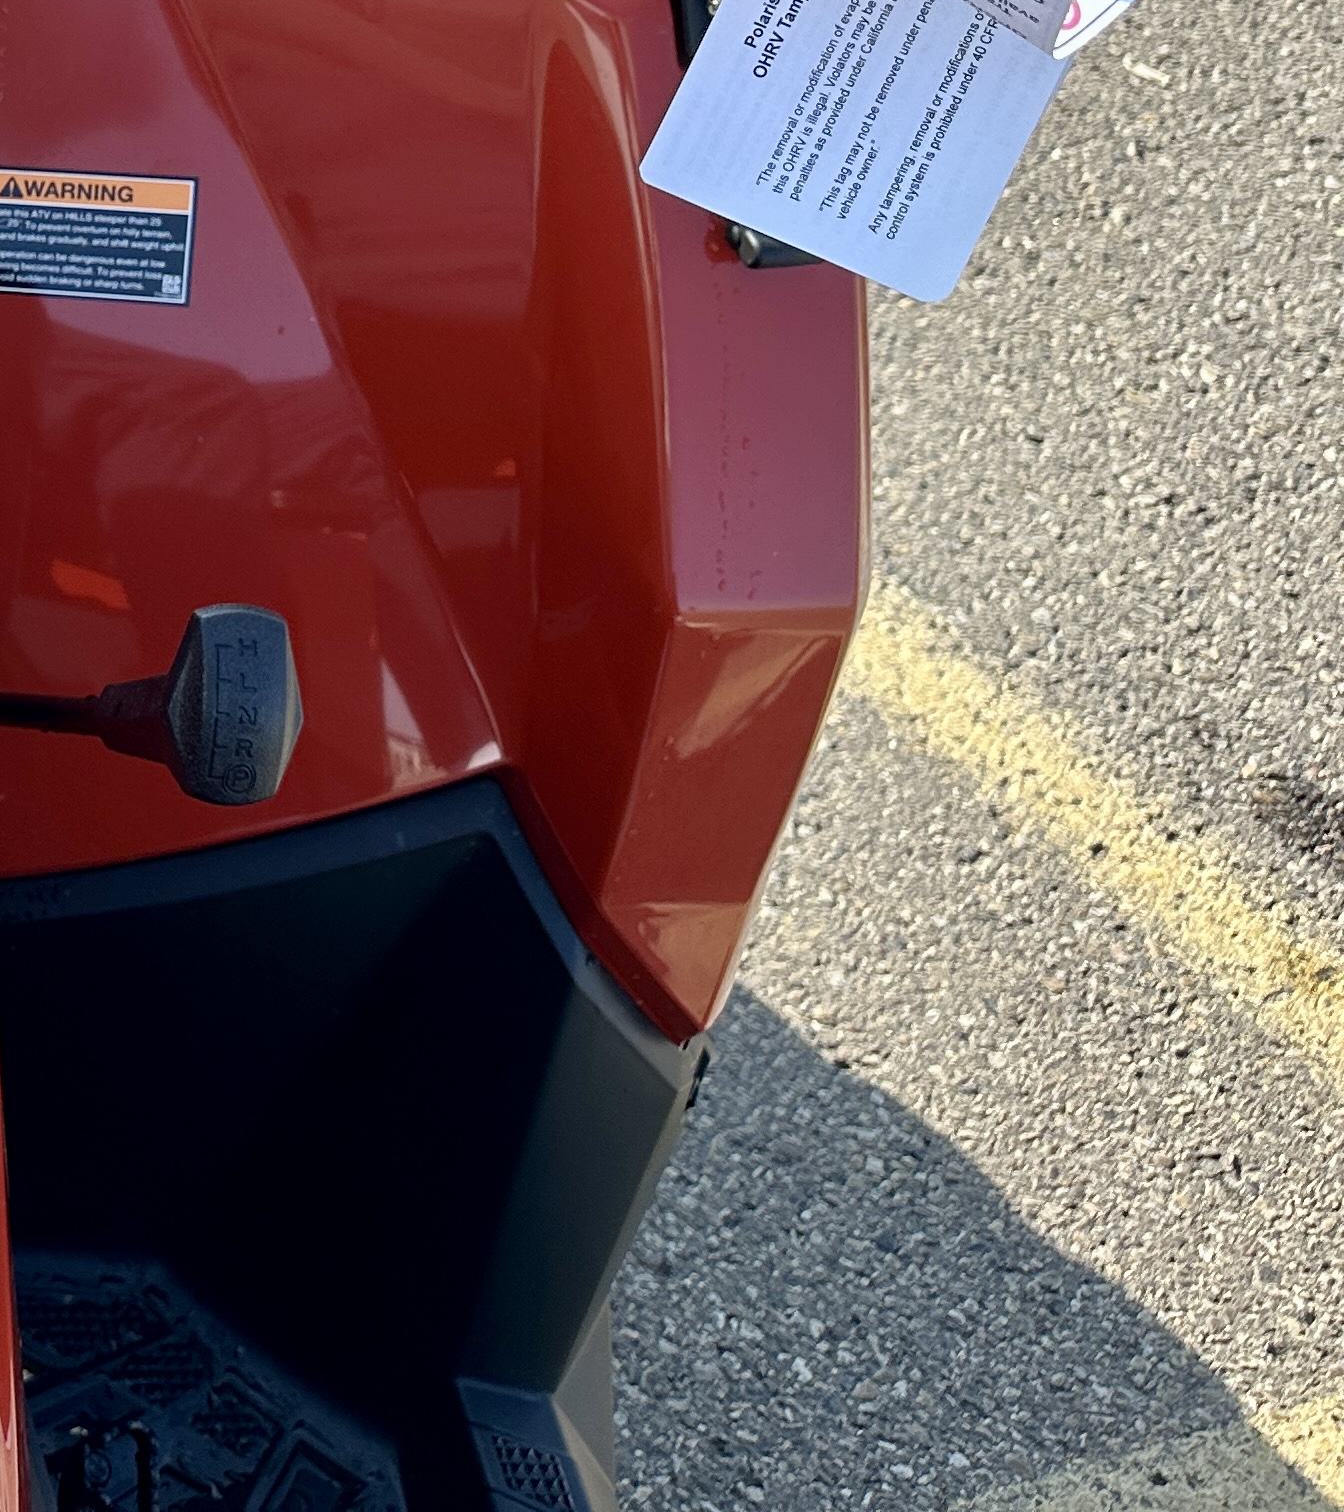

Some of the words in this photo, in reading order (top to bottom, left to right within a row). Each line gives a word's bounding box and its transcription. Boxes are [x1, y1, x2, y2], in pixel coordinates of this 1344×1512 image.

[861, 0, 877, 16] be
[850, 15, 870, 41] may
[899, 23, 921, 56] under
[753, 31, 784, 78] OHRV
[823, 42, 856, 87] Violators
[875, 56, 905, 105] removed
[806, 92, 831, 125] illegal.
[864, 106, 880, 121] be
[800, 126, 814, 137] is
[857, 121, 873, 141] not
[886, 202, 910, 240] control
[904, 163, 929, 202] system
[922, 151, 936, 162] is
[930, 95, 962, 151] prohibited
[957, 62, 978, 95] under
[972, 45, 987, 62] 40
[782, 136, 807, 172] OHRV
[844, 141, 864, 166] may
[772, 174, 790, 194] this
[834, 166, 853, 185] tag
[25, 180, 133, 203] WARNING
